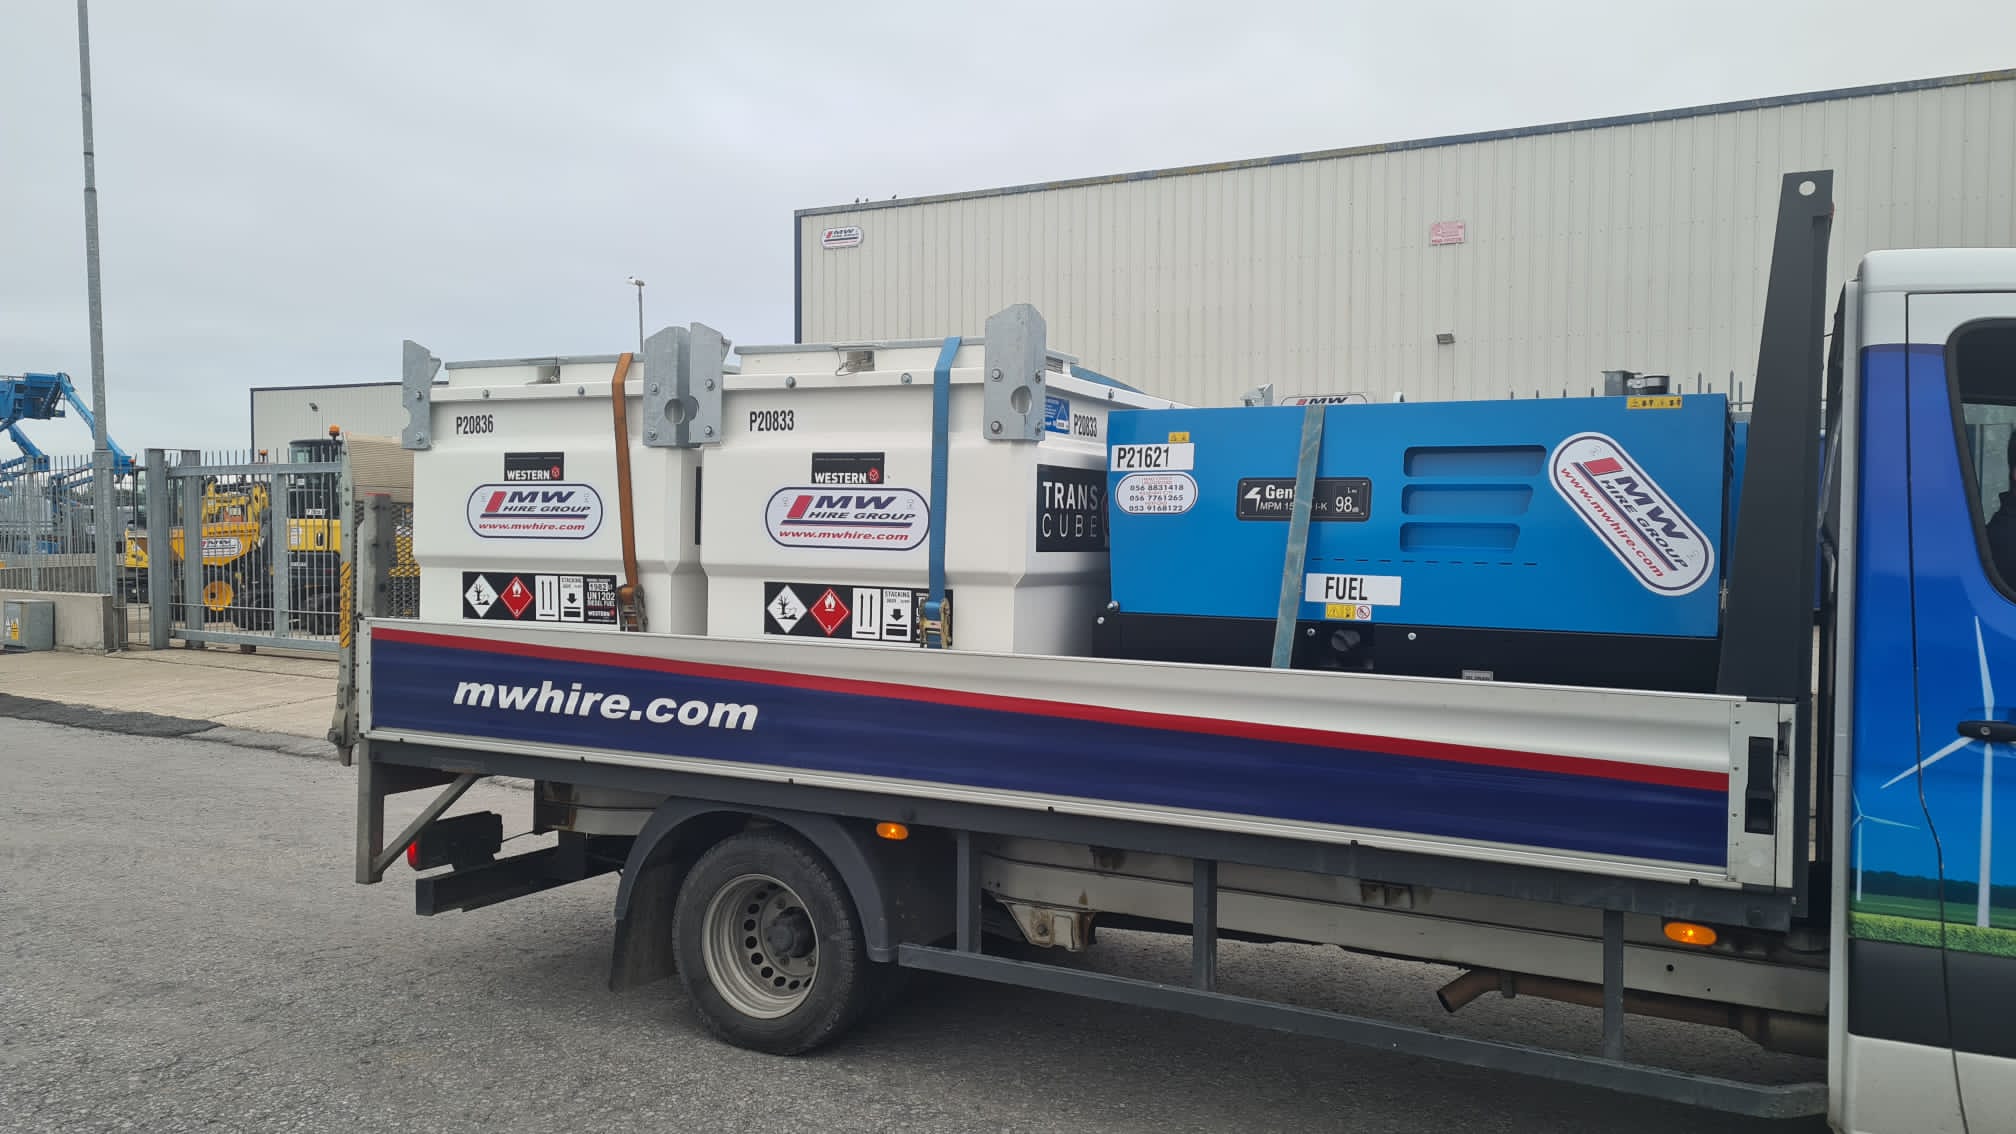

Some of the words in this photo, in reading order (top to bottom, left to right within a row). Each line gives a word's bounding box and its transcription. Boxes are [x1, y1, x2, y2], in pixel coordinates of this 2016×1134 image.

[456, 414, 494, 435] P20836
[750, 410, 794, 432] P20833
[1073, 413, 1097, 438] P20833
[1117, 446, 1170, 468] P21621
[506, 470, 550, 480] WESTERN
[814, 472, 867, 484] WESTERN
[508, 491, 575, 503] MW
[815, 495, 897, 509] MW
[1042, 481, 1098, 511] TRANS
[1260, 501, 1282, 510] MPM
[1335, 496, 1352, 512] 98
[808, 511, 850, 519] HIRE
[853, 512, 916, 520] GROUP
[1614, 476, 1689, 539] MW
[479, 522, 585, 531] www.mwhire.com
[1042, 512, 1097, 538] CUBE
[1561, 468, 1664, 577] www.mwhire.com
[1601, 479, 1638, 513] HIRE
[1636, 517, 1689, 567] GROUP
[779, 530, 909, 540] www.mwhire.com
[1325, 576, 1368, 601] FUEL
[452, 680, 759, 731] mwhire.com
